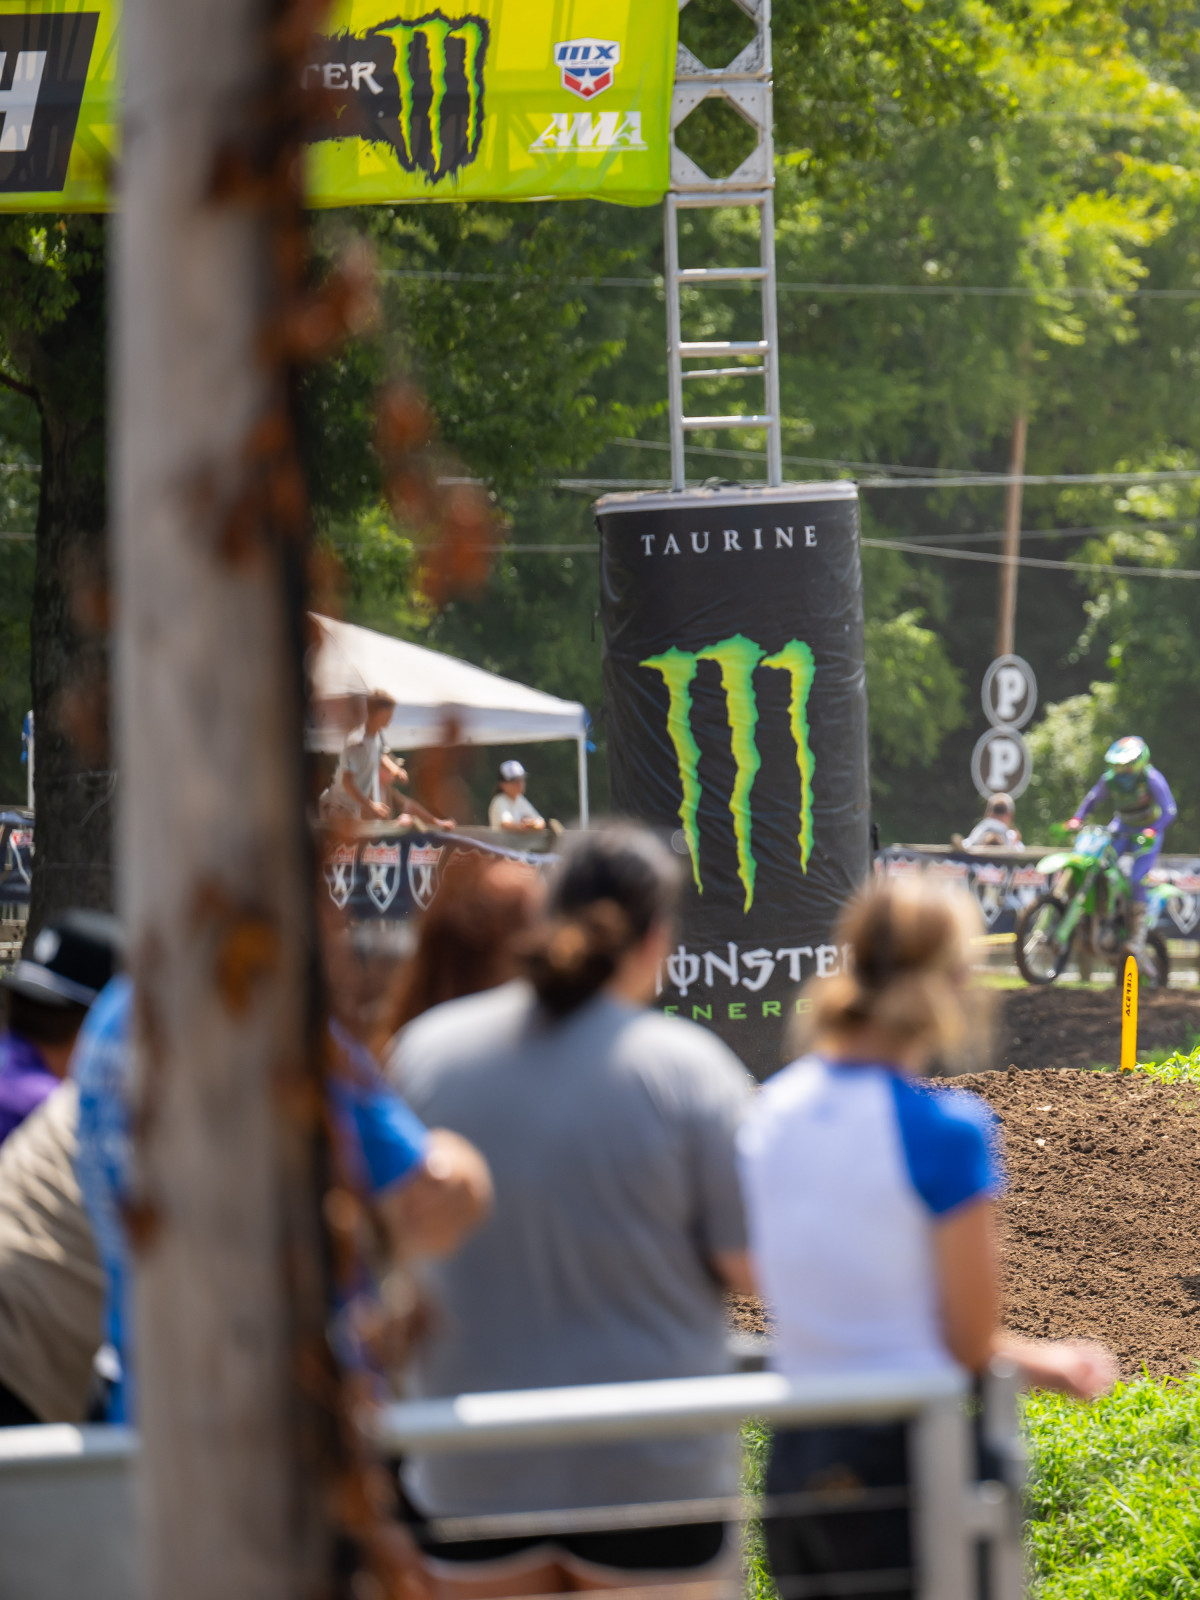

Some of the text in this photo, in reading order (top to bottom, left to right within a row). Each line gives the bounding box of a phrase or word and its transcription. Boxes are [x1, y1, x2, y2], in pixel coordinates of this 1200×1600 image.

[529, 111, 648, 147] AMA
[640, 525, 818, 557] TAURINE
[995, 665, 1027, 721] P
[986, 738, 1022, 792] P
[663, 998, 814, 1021] ENERG
